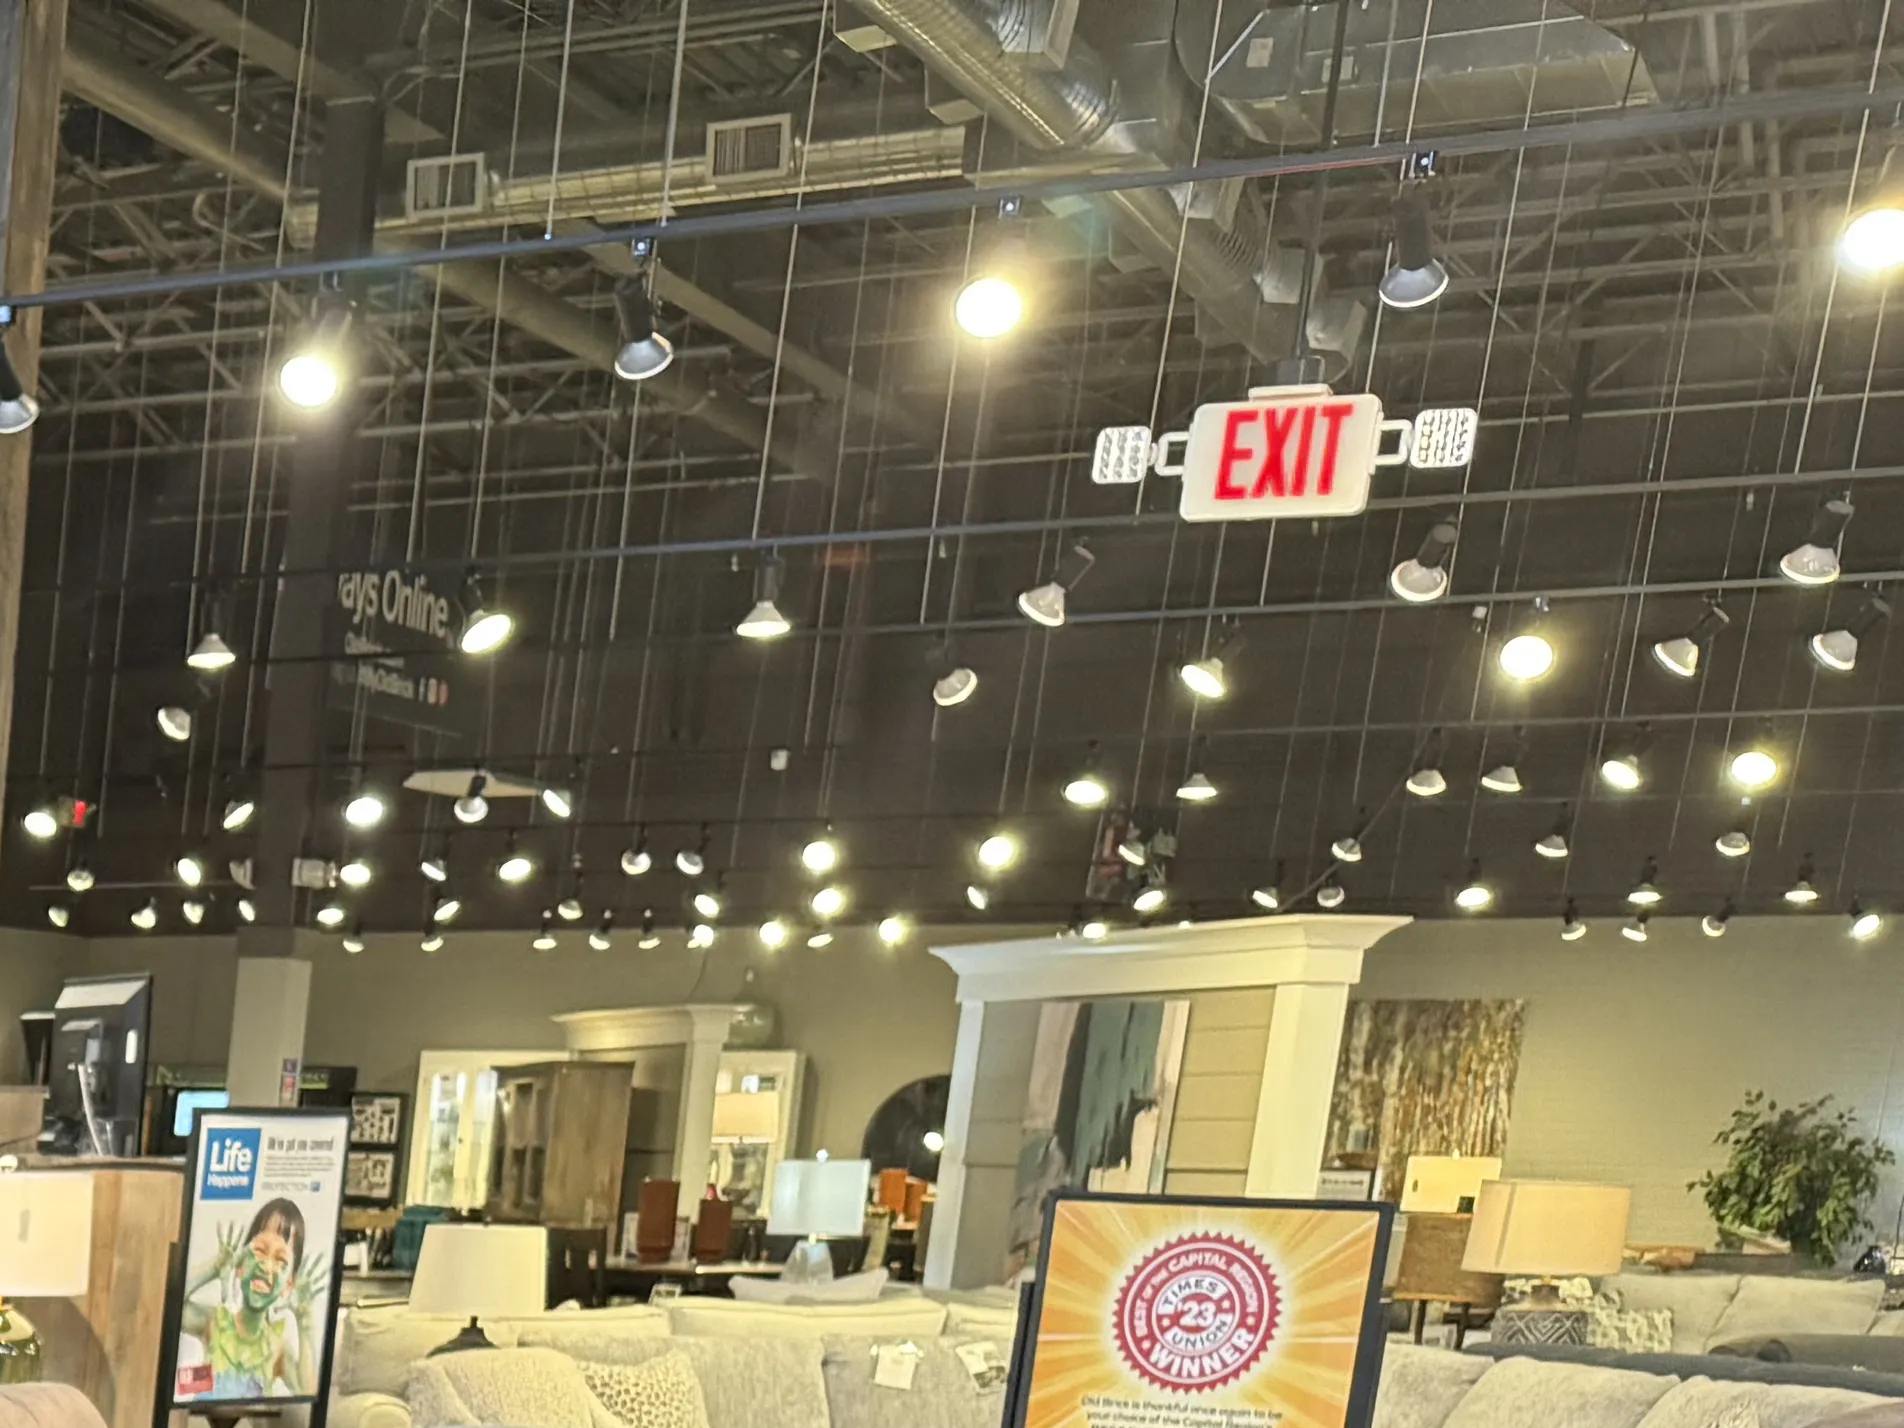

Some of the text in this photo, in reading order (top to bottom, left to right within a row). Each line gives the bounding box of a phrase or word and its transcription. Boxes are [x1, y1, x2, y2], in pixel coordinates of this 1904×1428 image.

[1214, 404, 1354, 500] EXIT
[207, 1138, 253, 1189] Life Happens
[1168, 1252, 1228, 1272] CAPITAL
[1162, 1279, 1219, 1306] TIMES
[1172, 1319, 1228, 1348] UNION
[1149, 1328, 1255, 1378] WINNER
[1143, 1401, 1188, 1413] thankful
